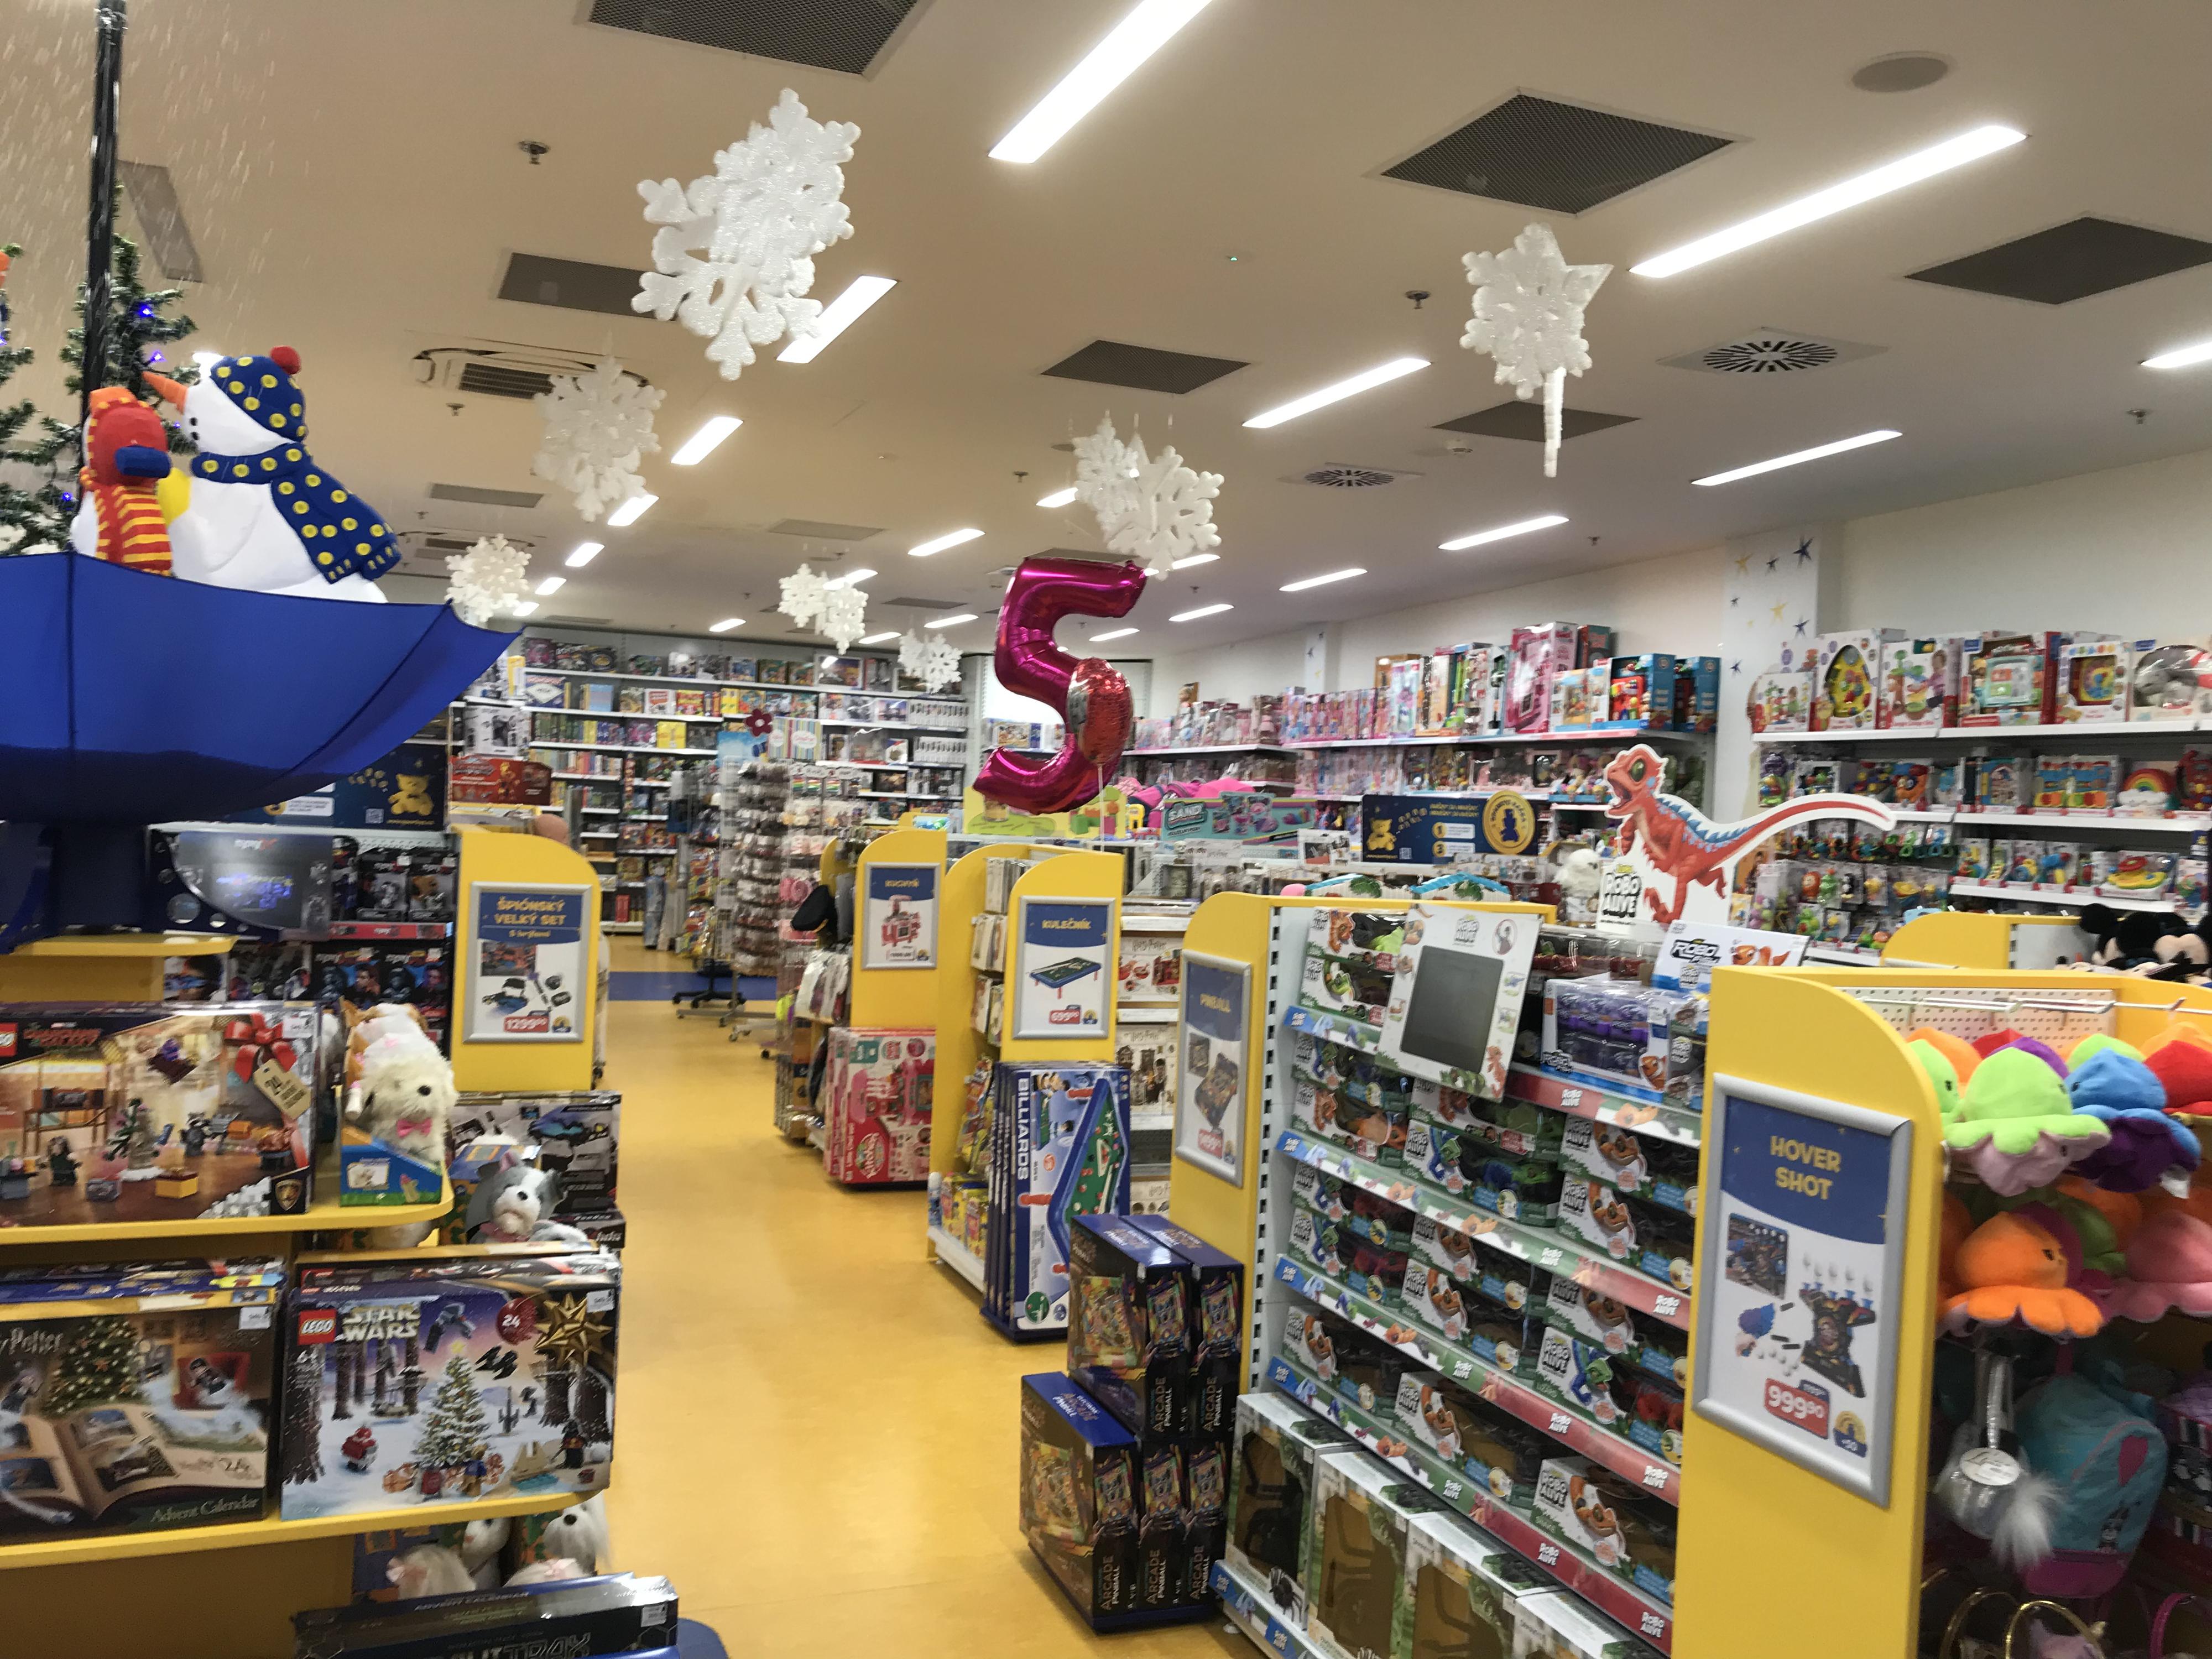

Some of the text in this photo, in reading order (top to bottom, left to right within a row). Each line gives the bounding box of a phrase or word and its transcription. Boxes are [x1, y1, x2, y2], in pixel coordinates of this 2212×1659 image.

[1605, 872, 1642, 896] ROBO
[494, 912, 566, 926] VELKÝ SET
[1602, 894, 1638, 918] ALIVE
[1042, 917, 1092, 930] KULEČNÍK
[1672, 940, 1719, 958] ROBO
[1017, 1077, 1030, 1181] BILLIARDS
[1770, 1135, 1841, 1173] HOVER
[1775, 1167, 1833, 1200] SHOT
[302, 1319, 335, 1334] LEGO
[343, 1305, 421, 1324] STAR
[502, 1314, 520, 1328] 24
[9, 1327, 63, 1355] Potter
[342, 1322, 420, 1343] WARS
[1152, 1376, 1167, 1433] ARCADE
[1202, 1376, 1218, 1433] ARCADE
[150, 1494, 260, 1522] Advent Calendar
[1100, 1555, 1114, 1610] ARCADE
[1146, 1548, 1161, 1604] ARCADE
[1190, 1545, 1205, 1600] ARCADE
